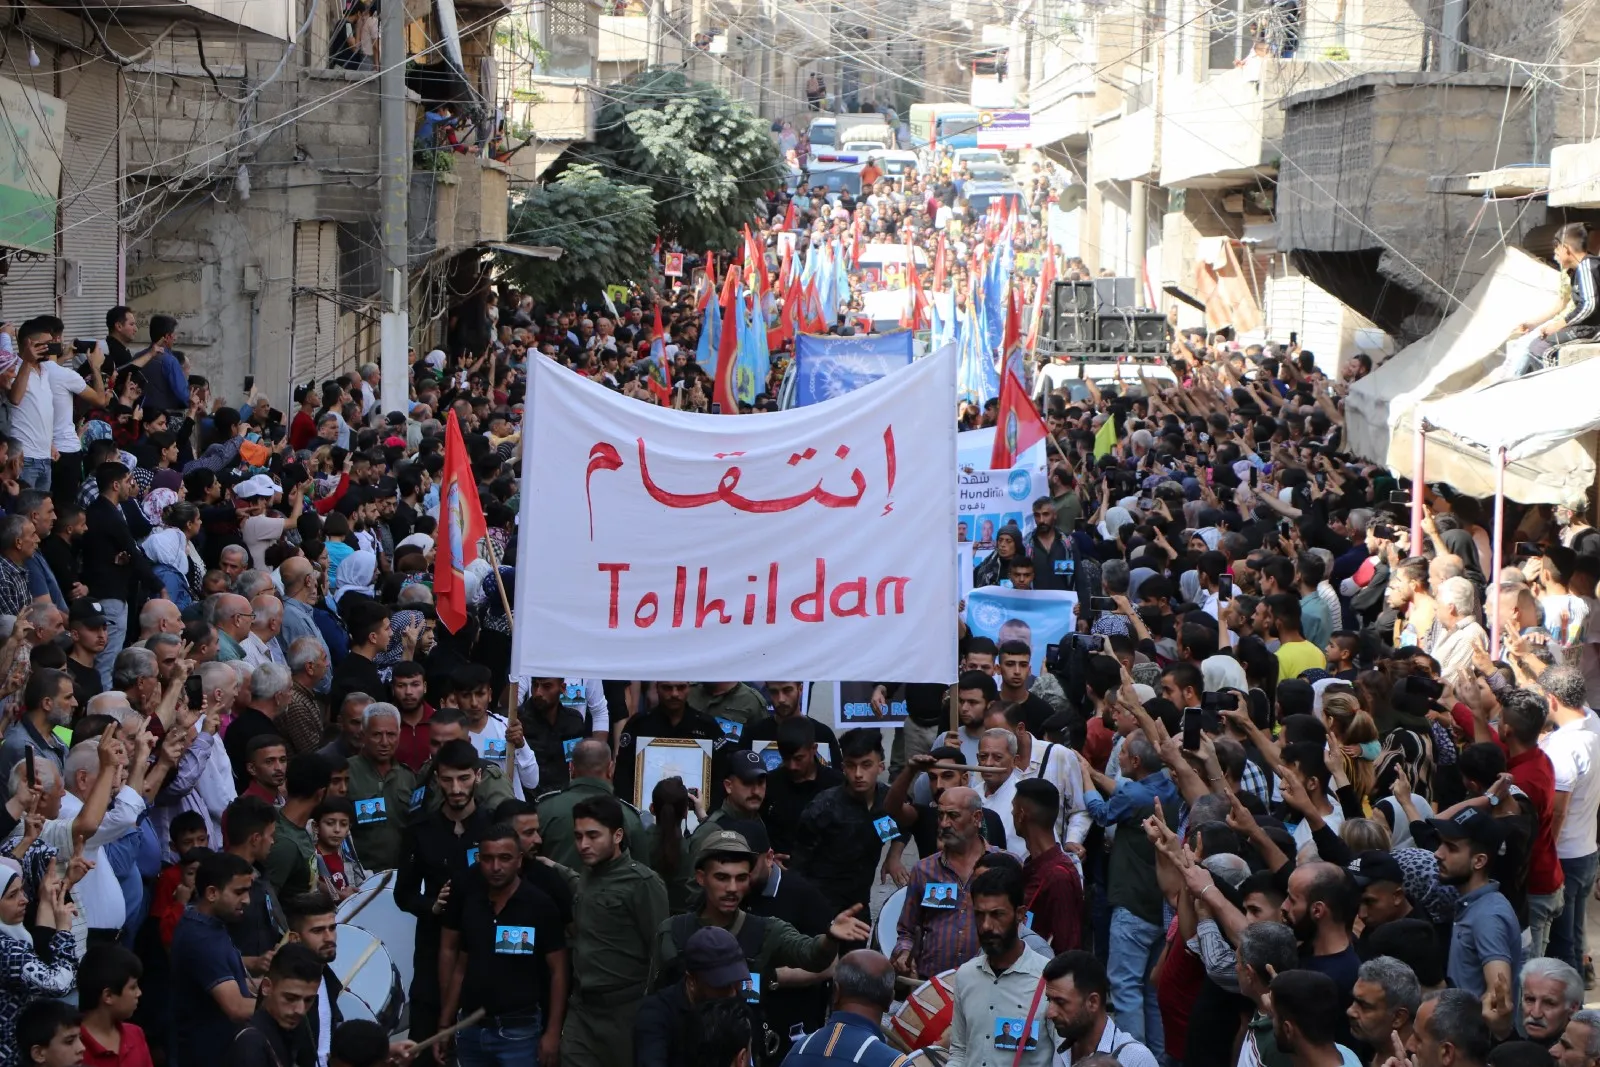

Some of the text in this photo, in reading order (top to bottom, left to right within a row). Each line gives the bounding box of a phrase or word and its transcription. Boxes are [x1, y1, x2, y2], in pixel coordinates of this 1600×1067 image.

[586, 424, 897, 542] إنتقام
[598, 557, 912, 629] Tolhildan
[844, 702, 889, 720] ŞEHD
